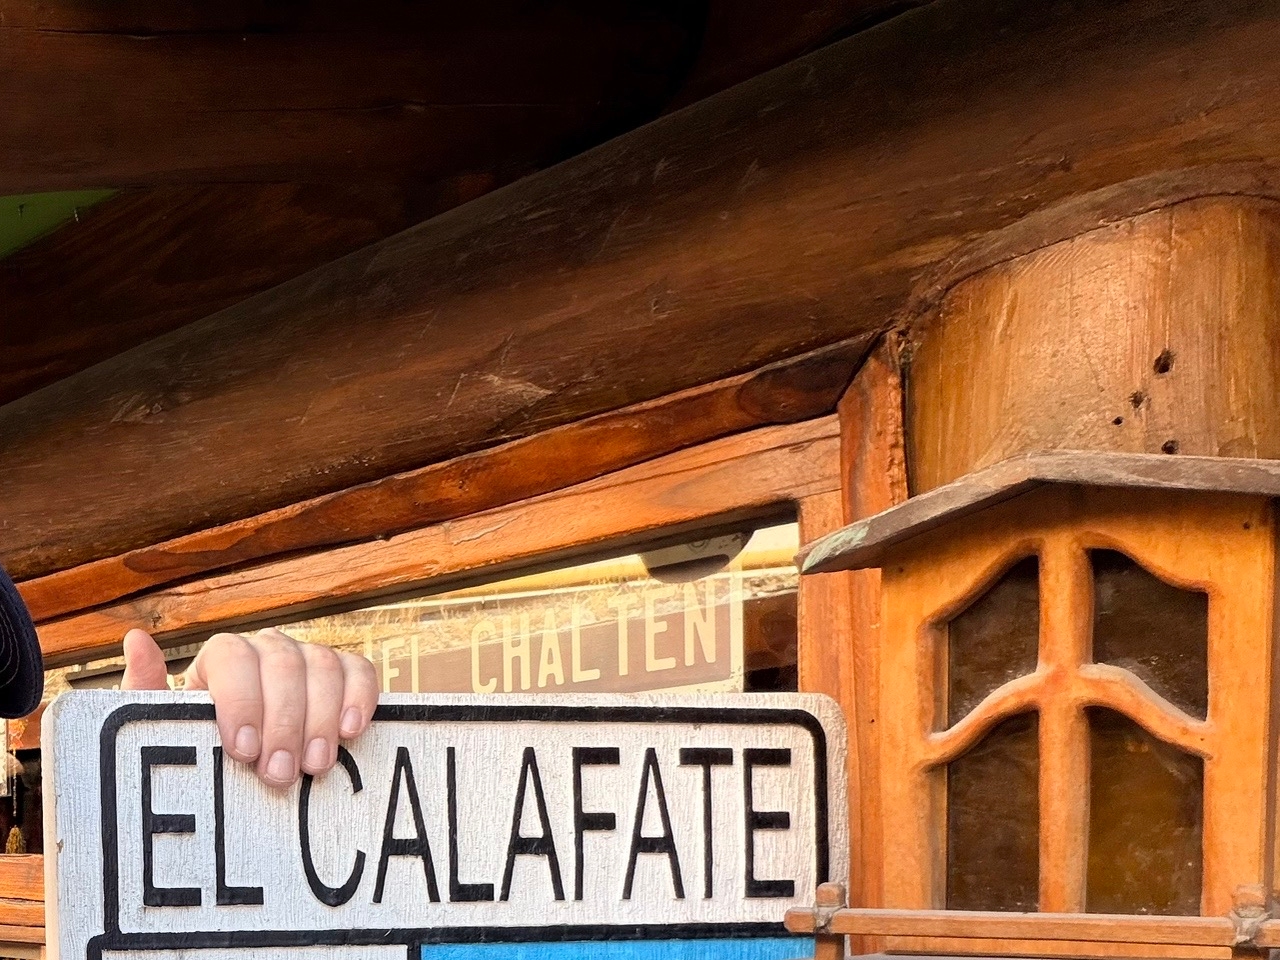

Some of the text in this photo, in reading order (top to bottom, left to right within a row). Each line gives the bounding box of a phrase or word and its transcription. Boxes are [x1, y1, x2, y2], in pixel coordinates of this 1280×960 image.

[471, 583, 717, 694] CHALTEN
[140, 744, 796, 908] EL CALAFATE
